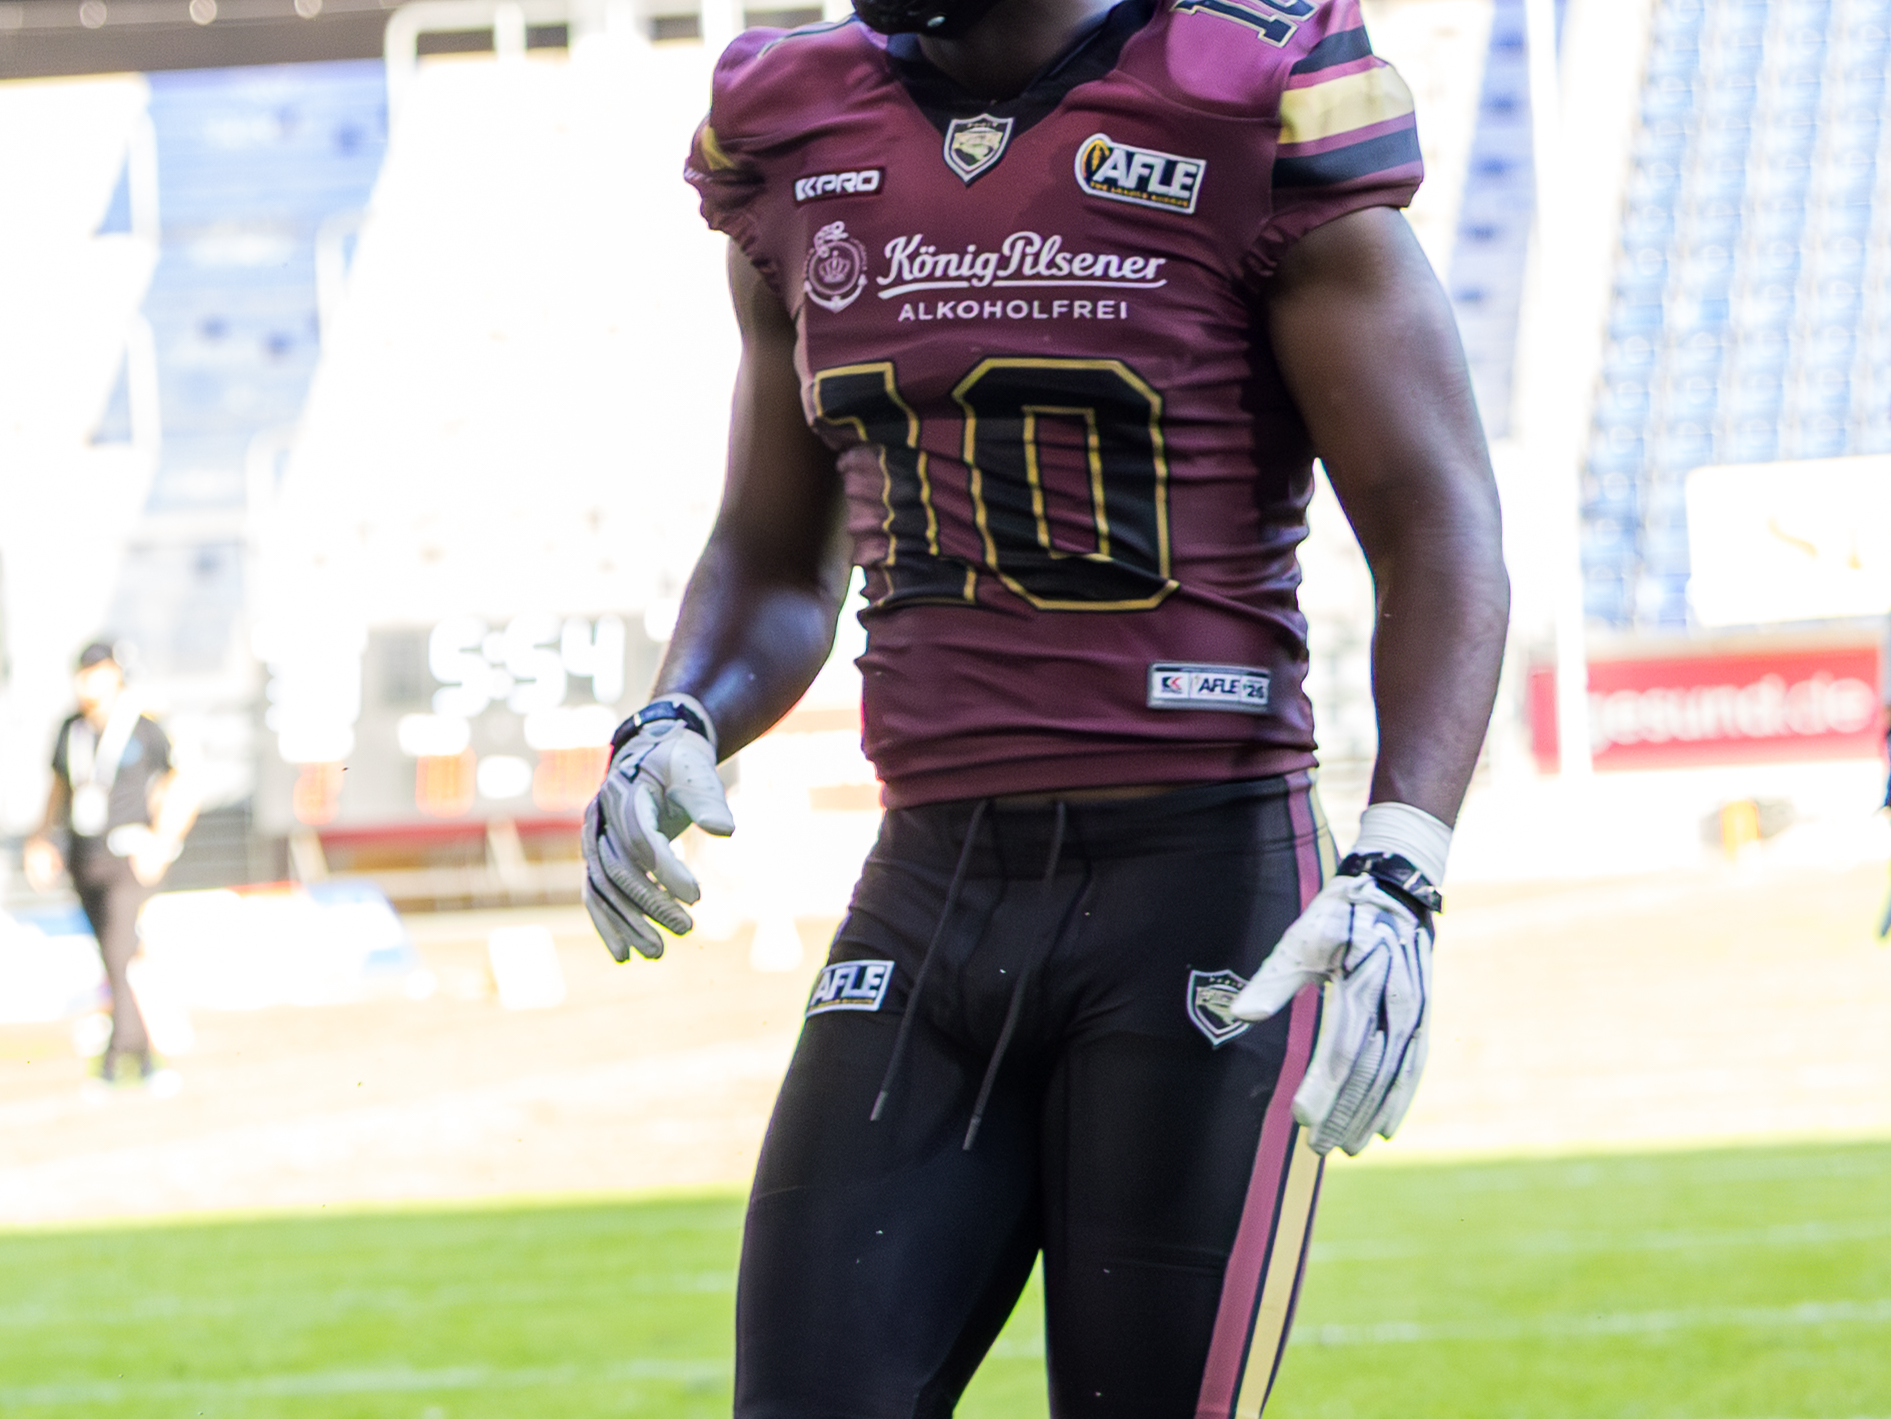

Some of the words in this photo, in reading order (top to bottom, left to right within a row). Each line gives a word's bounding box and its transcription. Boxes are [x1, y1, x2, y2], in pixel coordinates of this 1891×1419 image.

[1092, 147, 1198, 199] AFLE
[999, 230, 1167, 279] Pilsener
[897, 300, 1128, 322] ALKOHOLFREI
[811, 355, 1180, 612] 10
[428, 614, 626, 719] 5:54
[1198, 677, 1241, 694] AFLE
[809, 965, 885, 1006] AFLE
